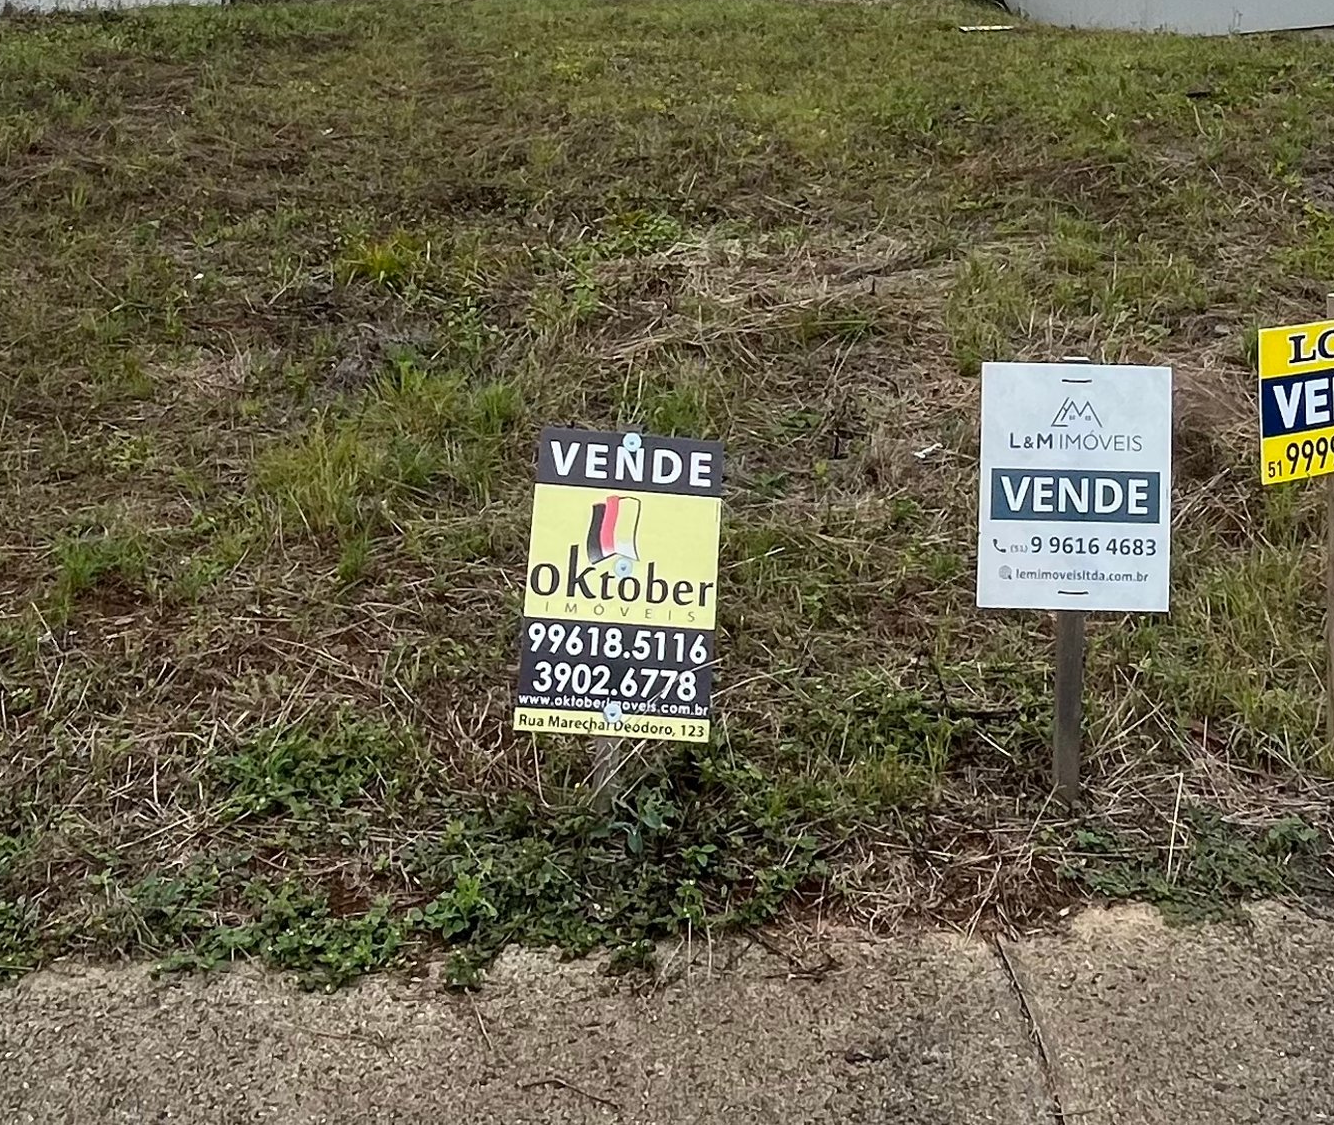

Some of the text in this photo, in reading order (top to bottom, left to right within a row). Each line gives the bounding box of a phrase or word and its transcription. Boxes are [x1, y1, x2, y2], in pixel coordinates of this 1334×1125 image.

[1009, 430, 1143, 452] L&M IMÓVEIS
[550, 440, 713, 488] VENDE
[1268, 460, 1283, 478] 51
[1000, 475, 1149, 515] VENDE
[1030, 536, 1042, 554] 9
[1049, 536, 1100, 555] 9616
[1105, 538, 1157, 556] 4683
[530, 544, 714, 607] oktober
[528, 622, 708, 665] 99618.5116
[532, 661, 697, 702] 3902.6778
[518, 714, 544, 727] Rua
[613, 719, 676, 737] Deodoro,
[681, 725, 705, 738] 123
